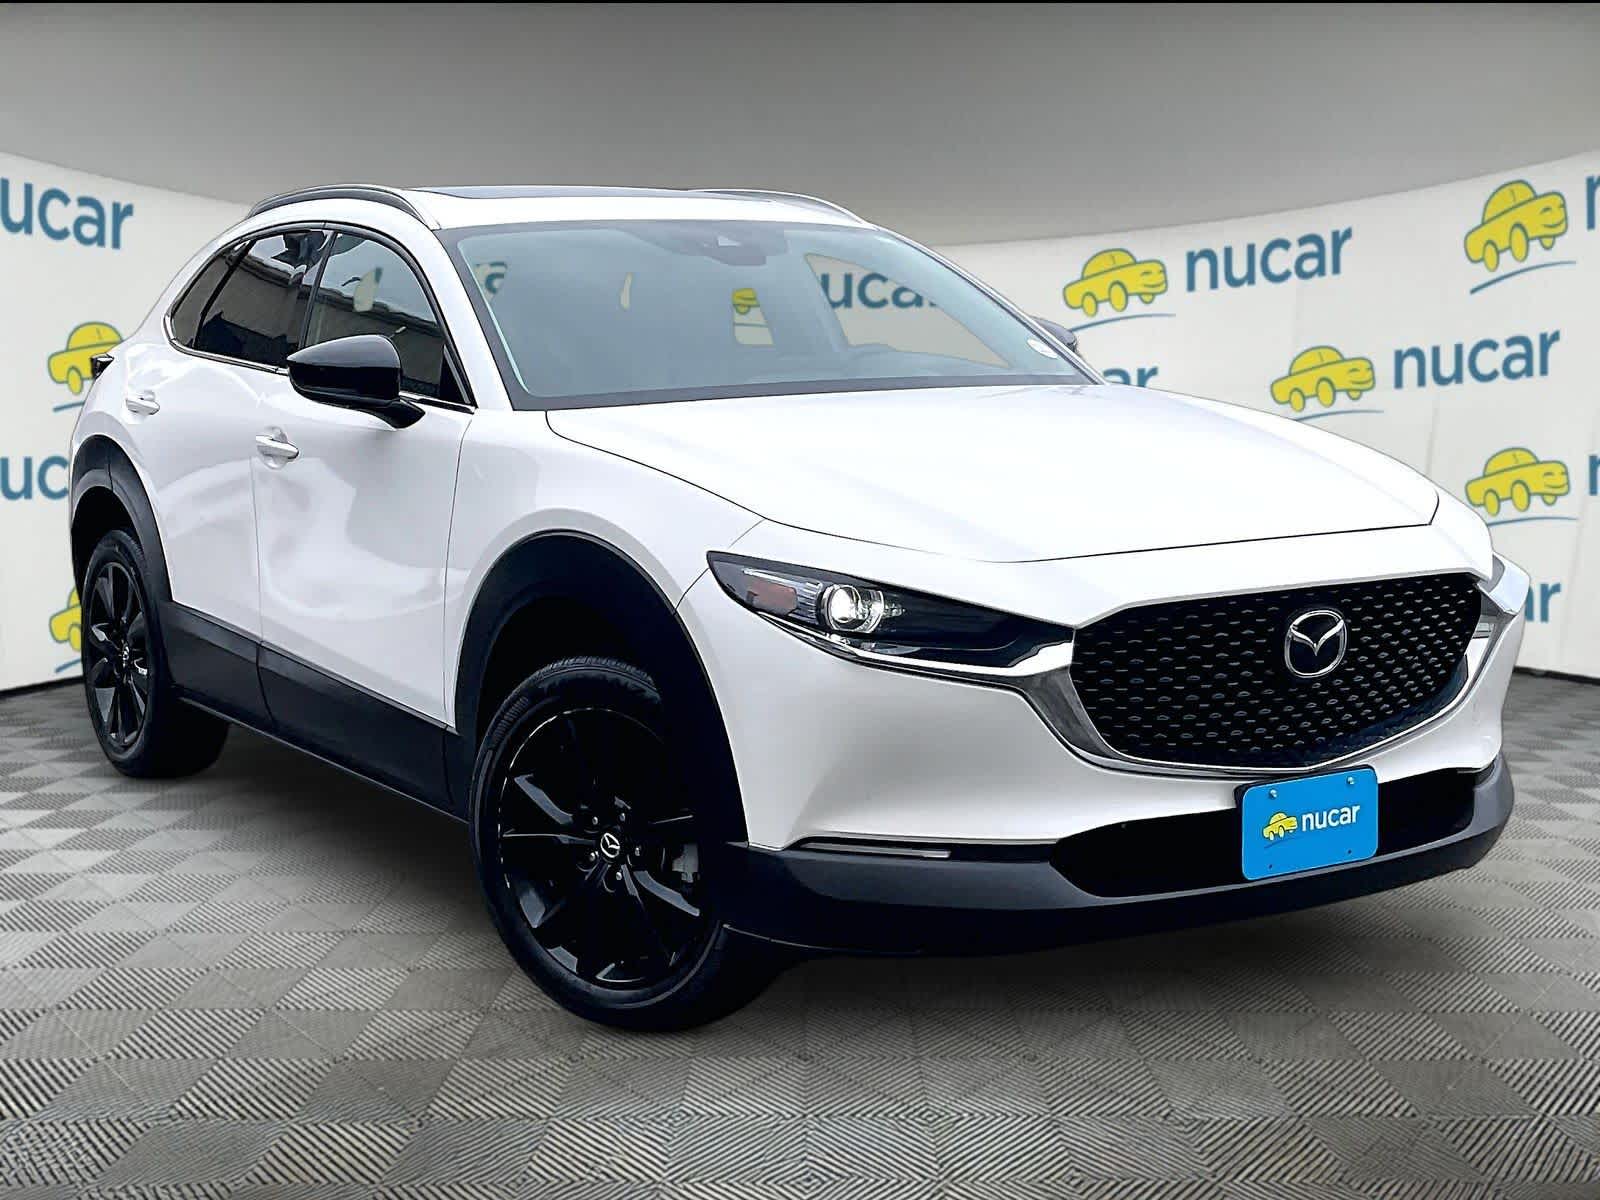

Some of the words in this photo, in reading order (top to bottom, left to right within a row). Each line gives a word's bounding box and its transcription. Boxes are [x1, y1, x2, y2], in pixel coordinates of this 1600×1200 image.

[1186, 226, 1352, 292] nucar
[820, 272, 937, 309] uca
[1394, 330, 1561, 389] nucar
[1302, 805, 1361, 832] nucar
